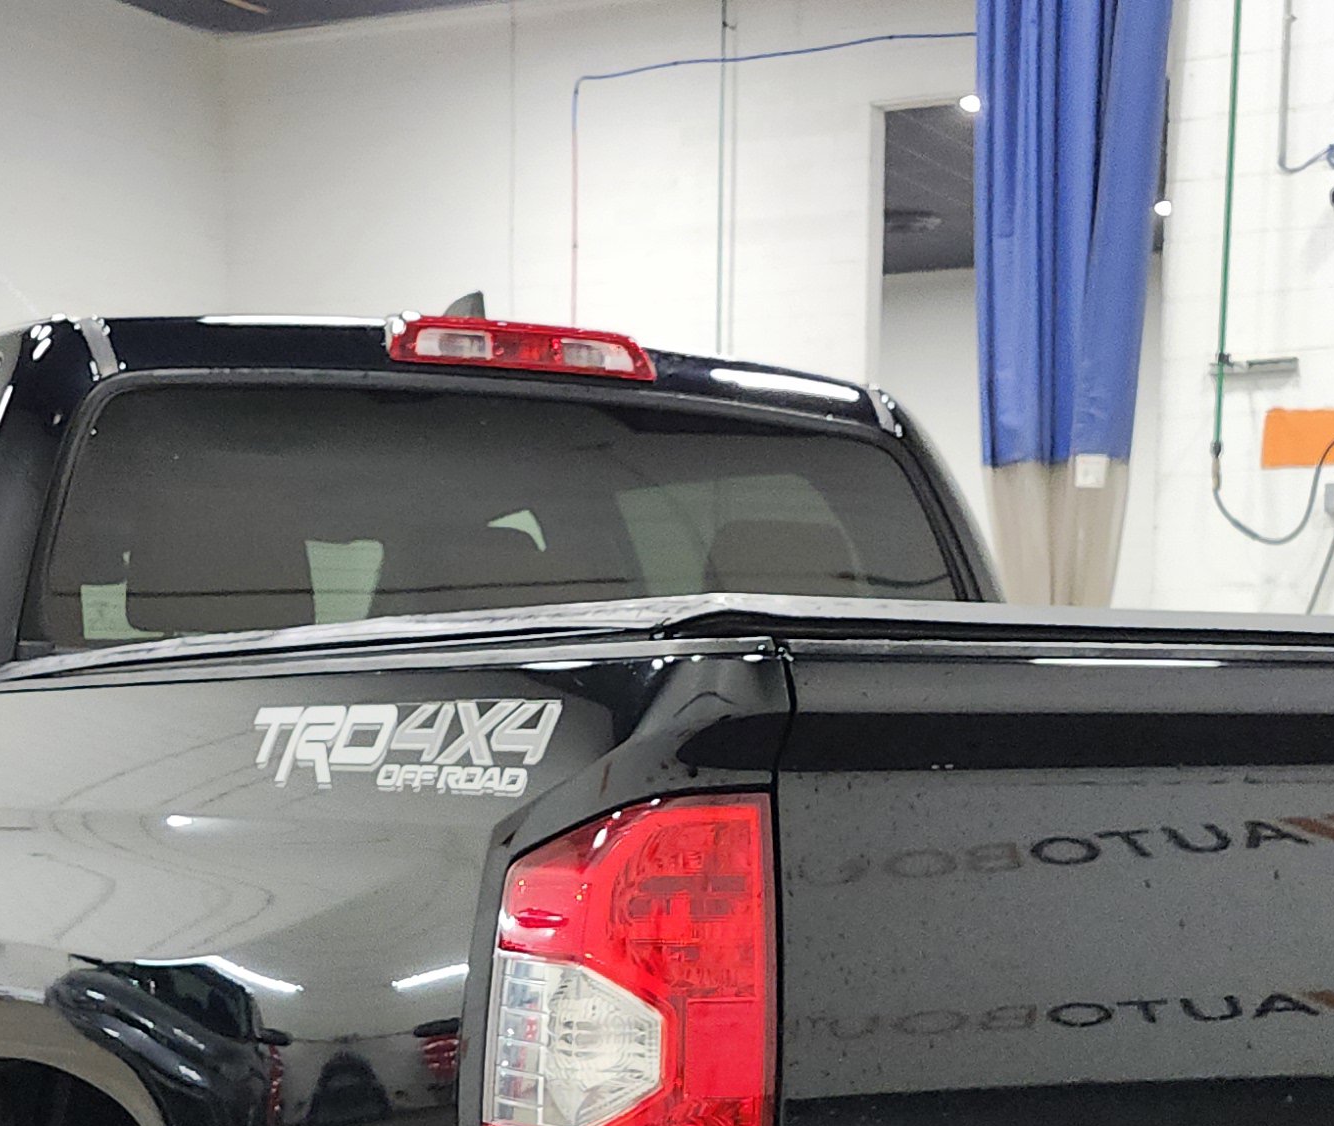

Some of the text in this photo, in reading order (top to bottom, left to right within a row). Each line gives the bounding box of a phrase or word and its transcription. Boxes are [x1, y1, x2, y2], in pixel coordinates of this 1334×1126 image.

[254, 699, 561, 789] TRD 4X4
[376, 764, 528, 796] OFF ROAD
